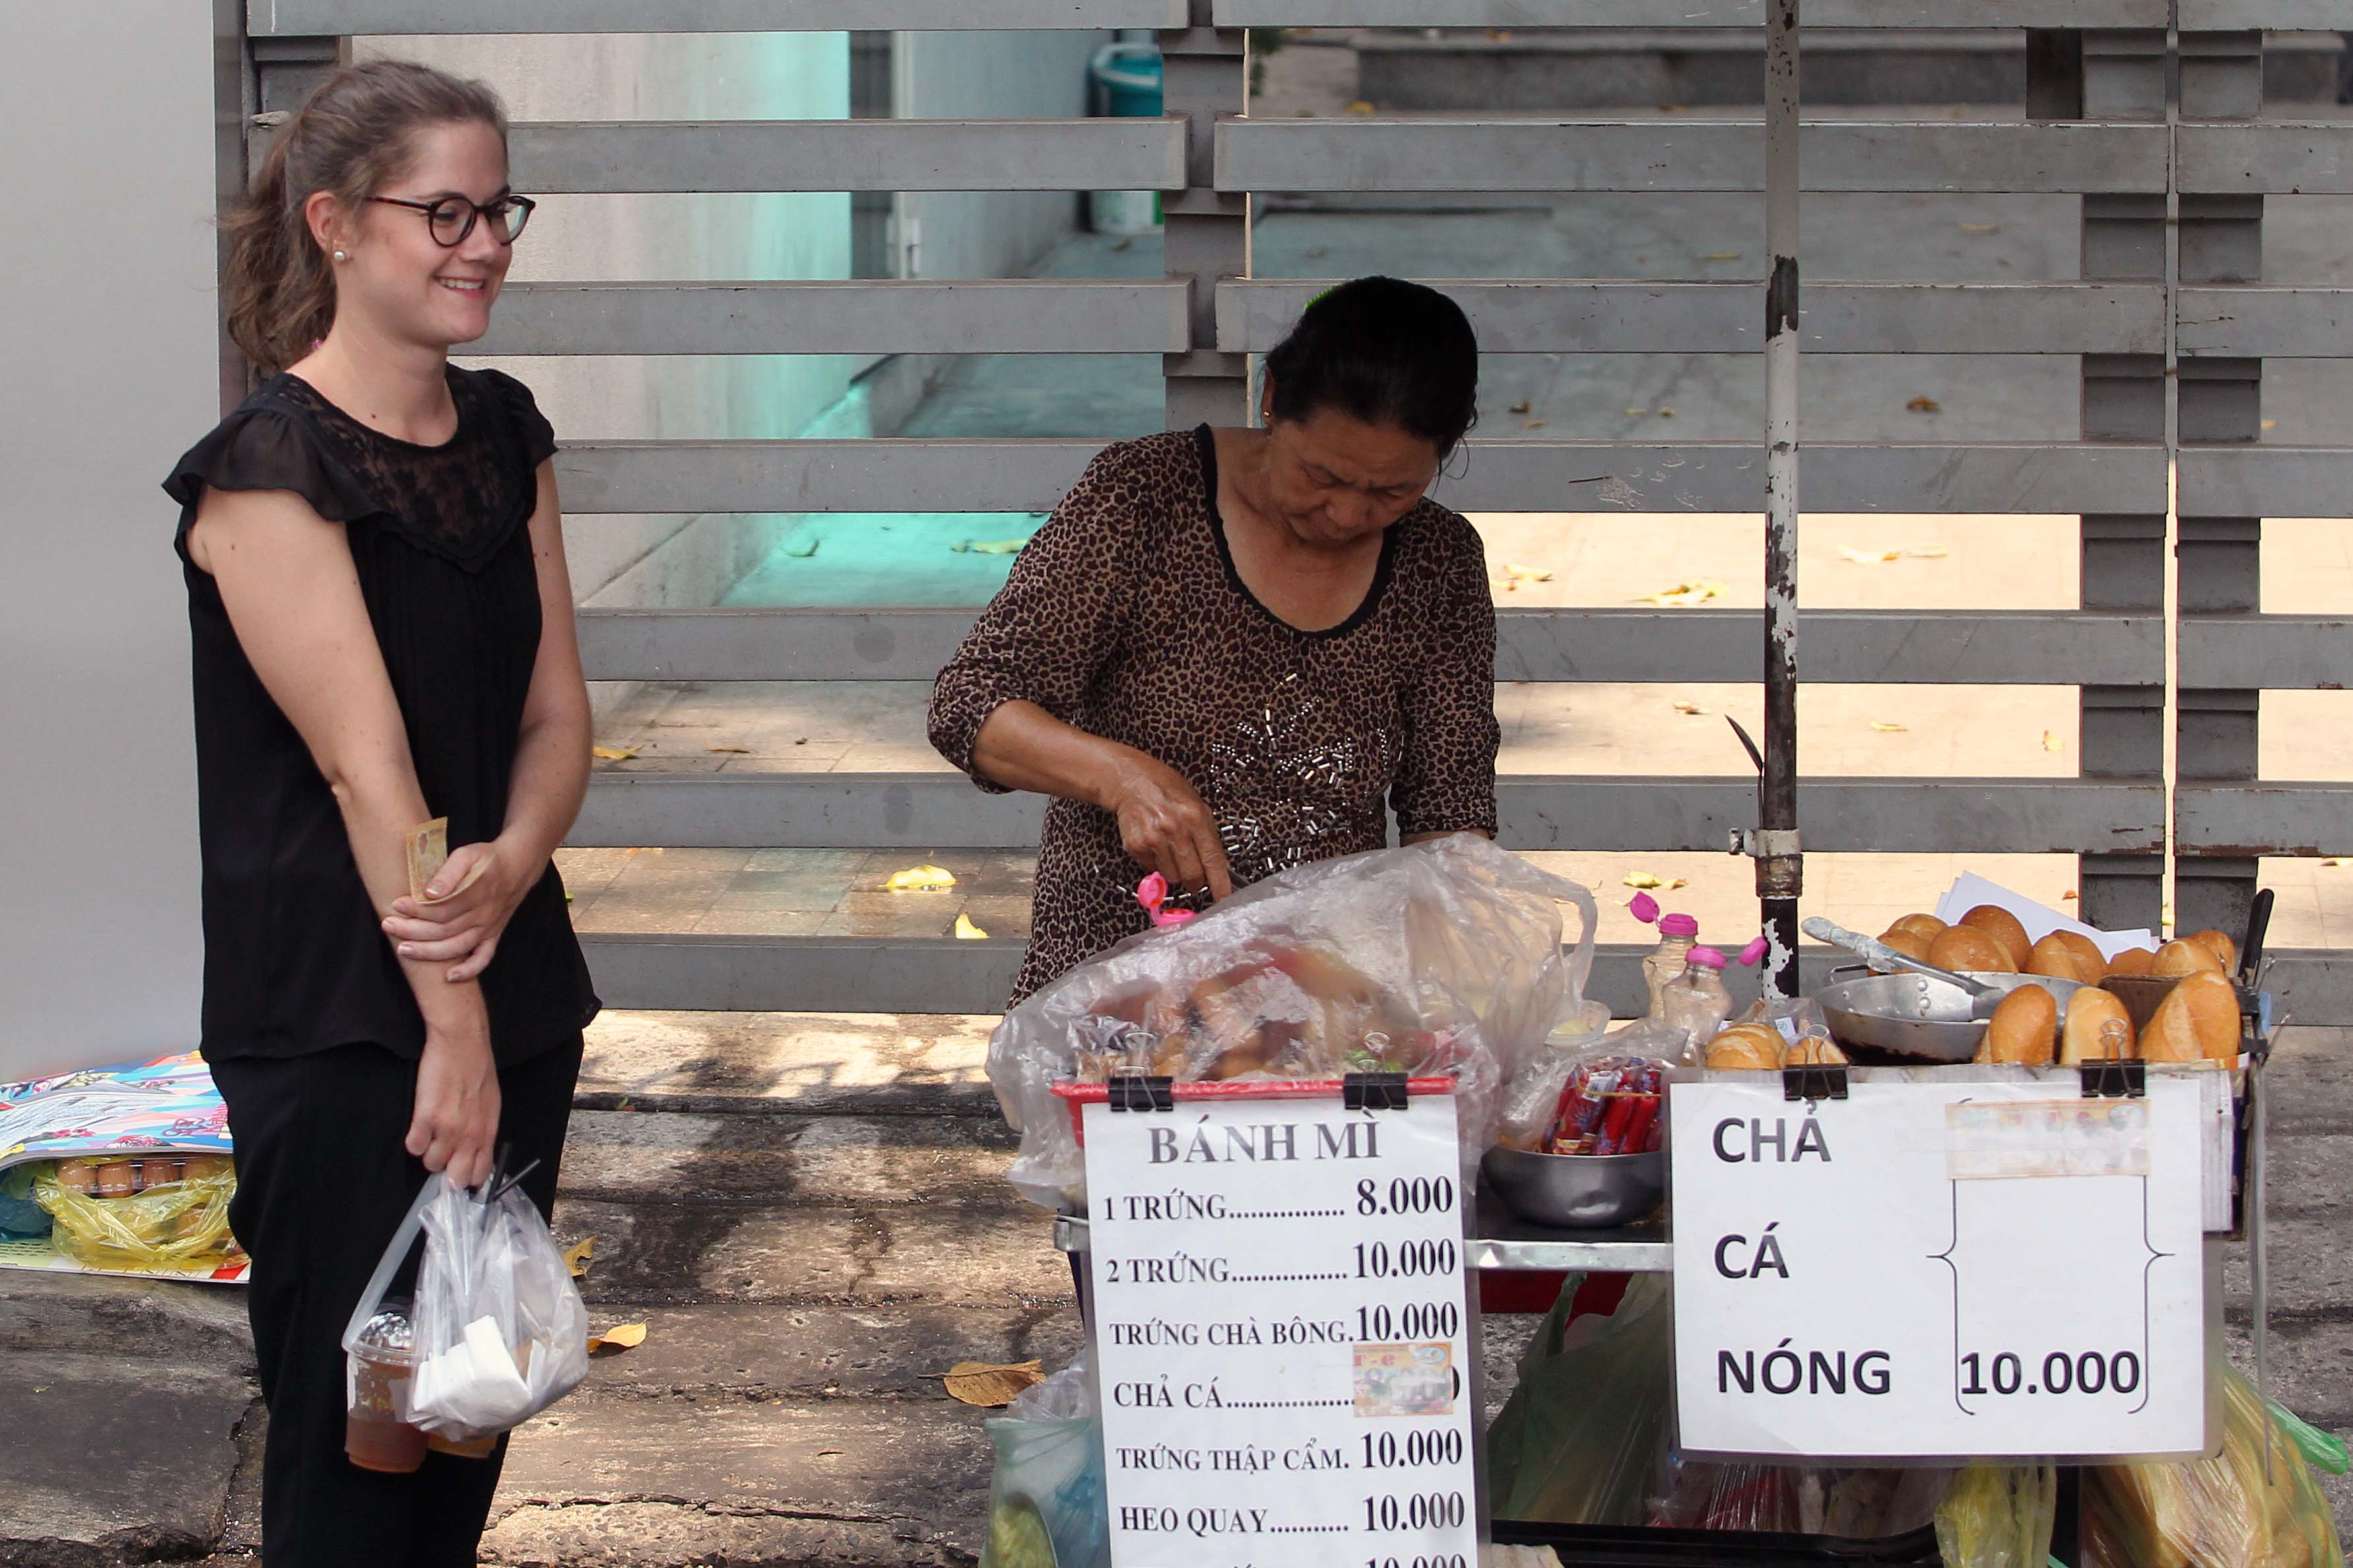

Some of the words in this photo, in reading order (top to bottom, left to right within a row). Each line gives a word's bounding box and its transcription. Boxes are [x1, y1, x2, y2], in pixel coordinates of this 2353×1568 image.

[1148, 1114, 1298, 1164] BÁNH
[1315, 1111, 1381, 1160] MÌ
[1713, 1099, 1832, 1163] CHẢ
[1105, 1196, 1115, 1220] 1
[1357, 1175, 1453, 1216] 8.000
[1106, 1259, 1120, 1283] 2
[1354, 1238, 1455, 1278] 10.000
[1714, 1222, 1790, 1279] CÁ
[1109, 1317, 1199, 1346] TRỨNG
[1207, 1316, 1262, 1346] CHÀ
[1356, 1301, 1458, 1342] 10.000
[1717, 1337, 1890, 1395] NÓNG
[1960, 1350, 2140, 1395] 10.000
[1113, 1373, 1174, 1408] CHẢ
[1115, 1443, 1201, 1470] TRỨNG
[1208, 1443, 1276, 1475] THẬP
[1361, 1428, 1463, 1468] 10.000
[1120, 1506, 1179, 1532] HEO
[1363, 1491, 1465, 1532] 10.000
